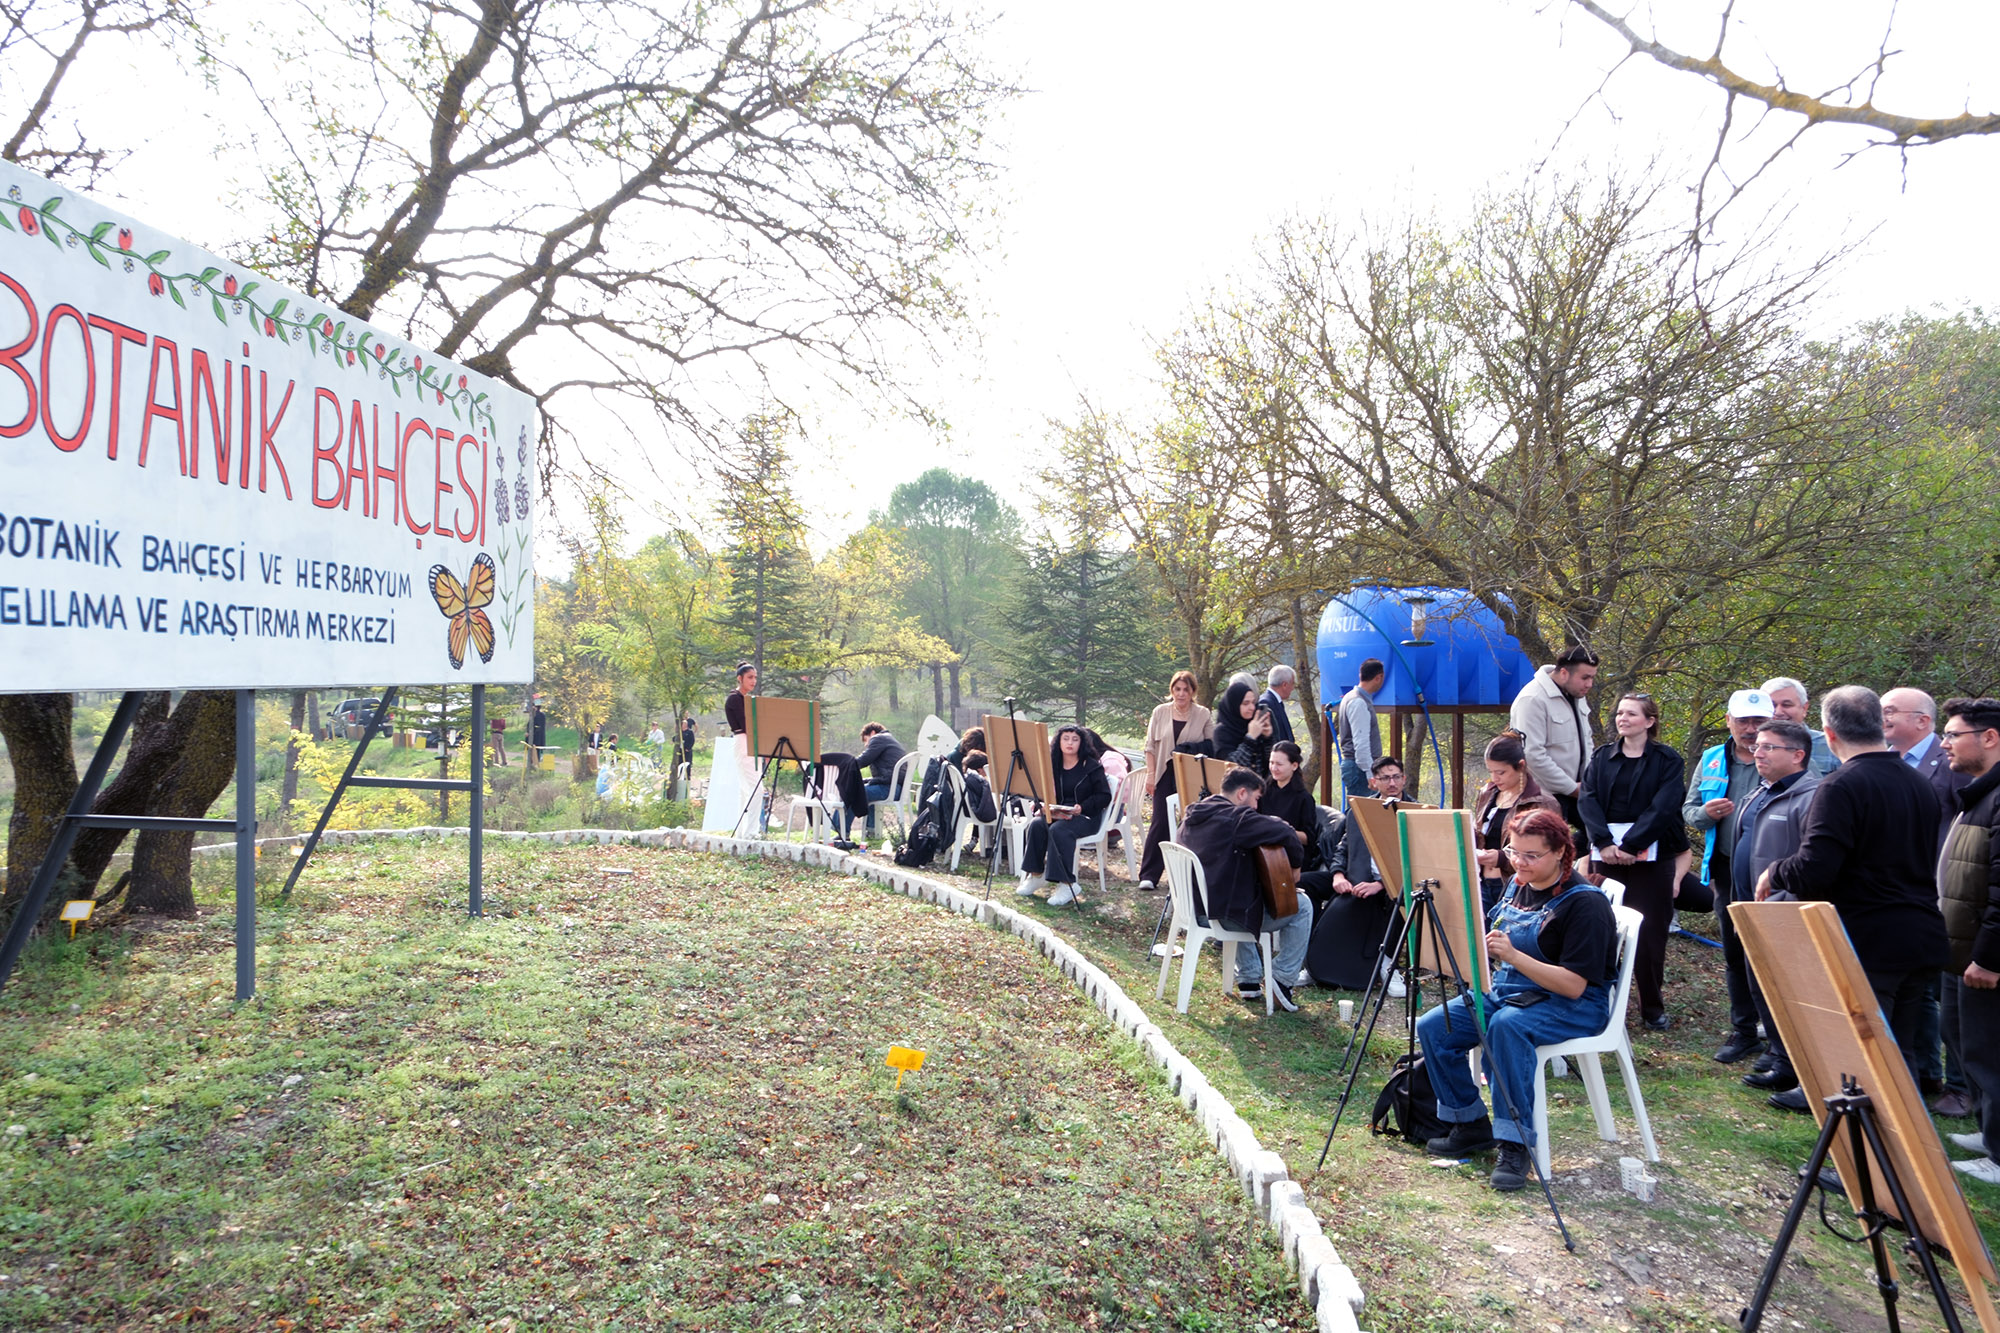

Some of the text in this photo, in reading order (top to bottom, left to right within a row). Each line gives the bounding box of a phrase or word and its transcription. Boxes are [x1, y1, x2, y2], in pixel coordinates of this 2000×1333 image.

[311, 386, 488, 550] BAHÇESİ
[142, 534, 246, 582] BAHÇESİ
[259, 551, 282, 585] VE
[296, 558, 412, 598] HERBARYUM
[136, 596, 168, 634] VE
[179, 599, 300, 641] ARAŞTIRMA
[306, 608, 395, 644] MERKEZİ
